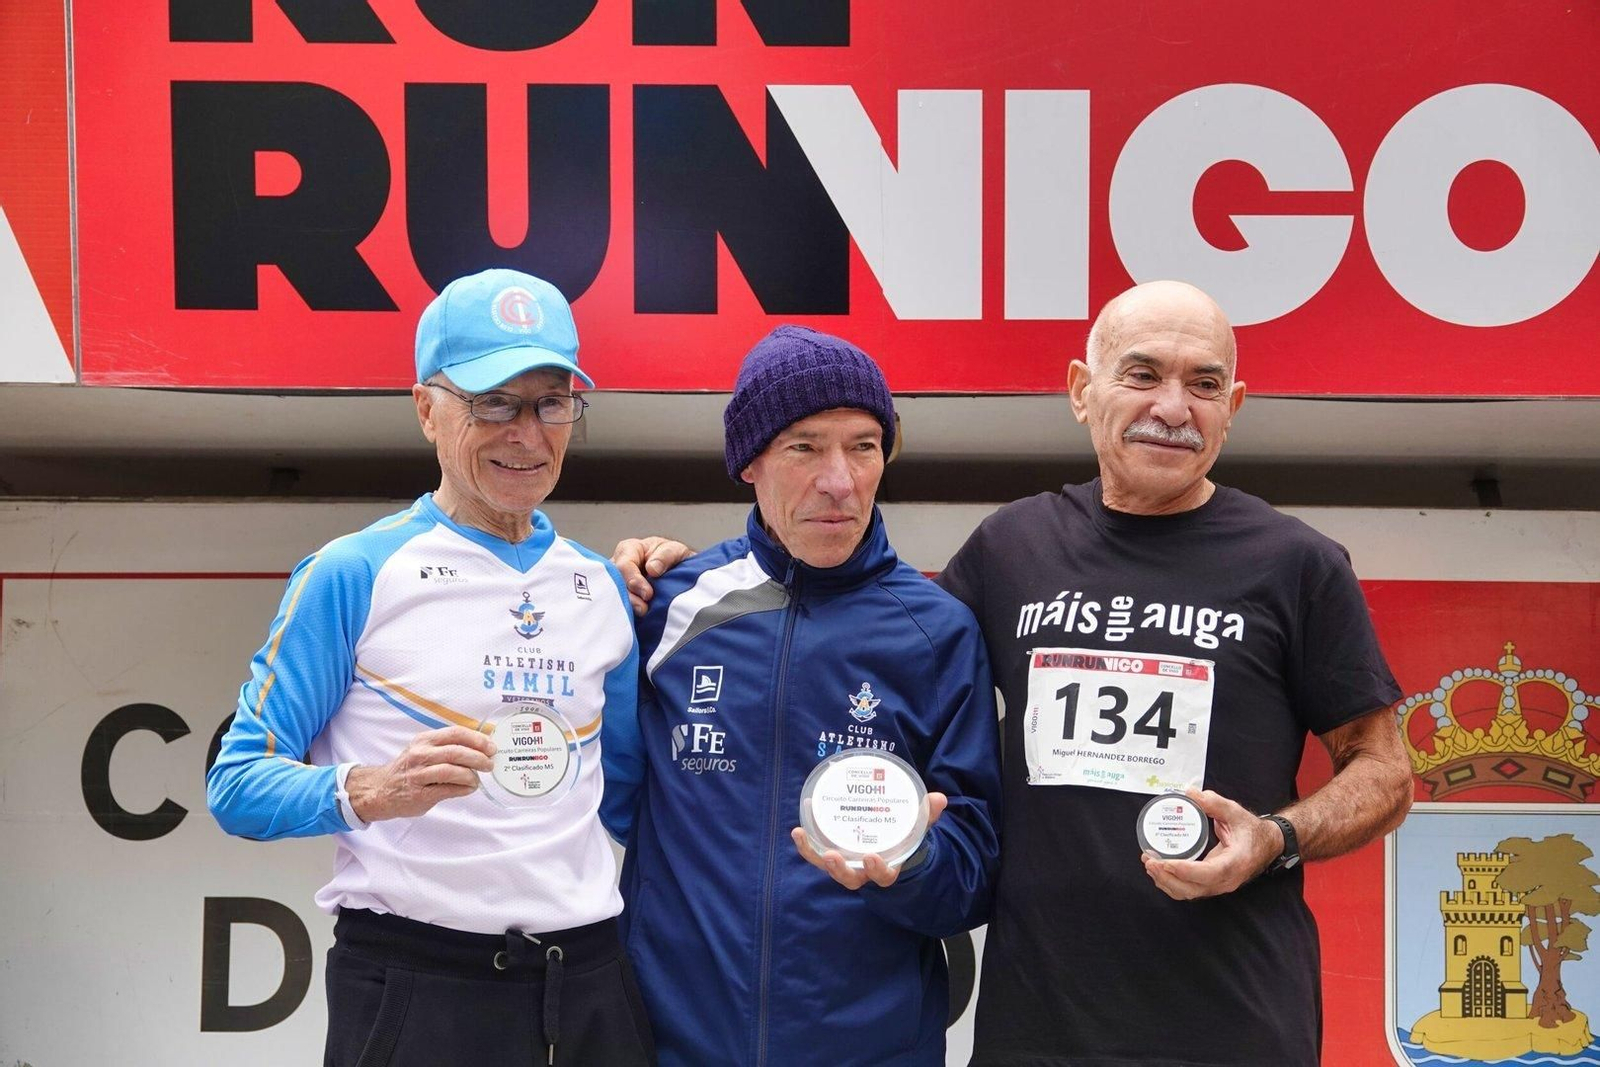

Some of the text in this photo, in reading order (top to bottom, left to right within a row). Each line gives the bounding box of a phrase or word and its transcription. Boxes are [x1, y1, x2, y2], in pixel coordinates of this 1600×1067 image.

[1016, 591, 1101, 638] máis
[1140, 602, 1245, 649] auga
[483, 655, 575, 672] ATLETISMO
[483, 669, 575, 696] SAMIL
[1055, 682, 1177, 749] 134
[691, 724, 726, 754] FE
[848, 724, 873, 735] CLUB
[819, 731, 896, 752] ATLETISMO
[681, 757, 737, 775] seguros
[1052, 749, 1166, 765] Miguel HERNANDEZ BORREGO
[842, 815, 883, 823] Clasificado
